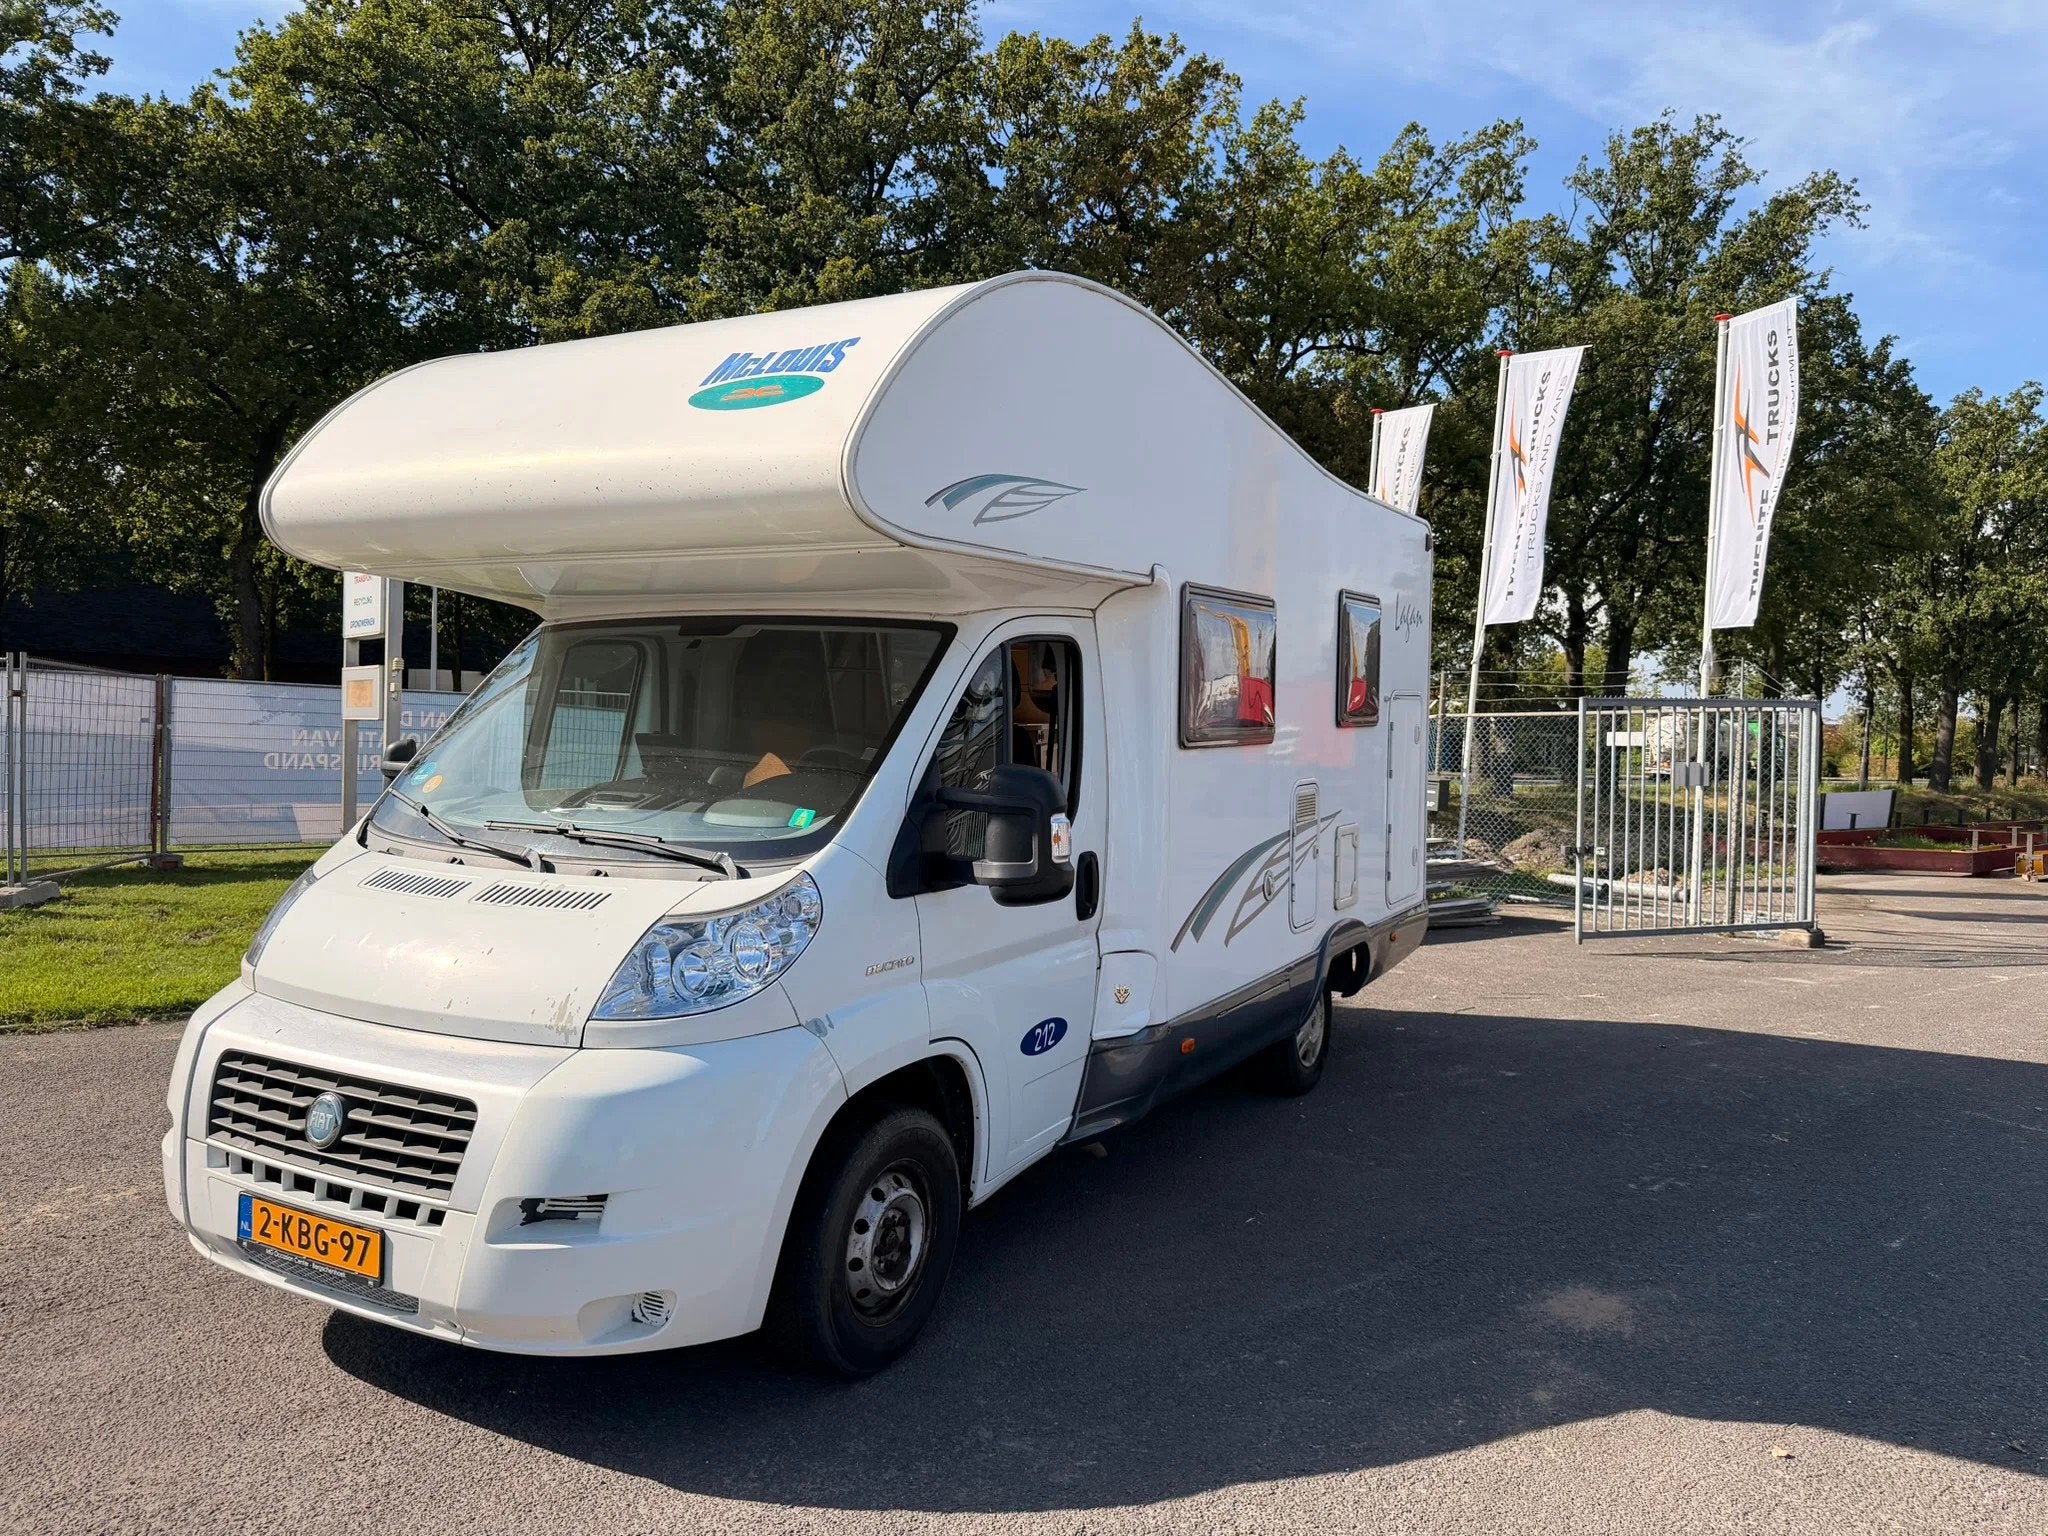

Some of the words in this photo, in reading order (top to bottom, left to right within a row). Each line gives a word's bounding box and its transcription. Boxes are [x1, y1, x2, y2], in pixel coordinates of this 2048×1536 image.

[1766, 329, 1780, 446] TRUCKS
[1505, 504, 1526, 601] TWENTE
[1528, 370, 1551, 467] TRUCKS
[1526, 481, 1543, 563] TRUCKS
[1539, 433, 1552, 475] AND
[1547, 375, 1568, 429] VANS
[1033, 1022, 1056, 1052] 212
[309, 1110, 334, 1131] FIAT
[241, 1220, 251, 1232] NL
[259, 1206, 371, 1267] 2-KBG-97
